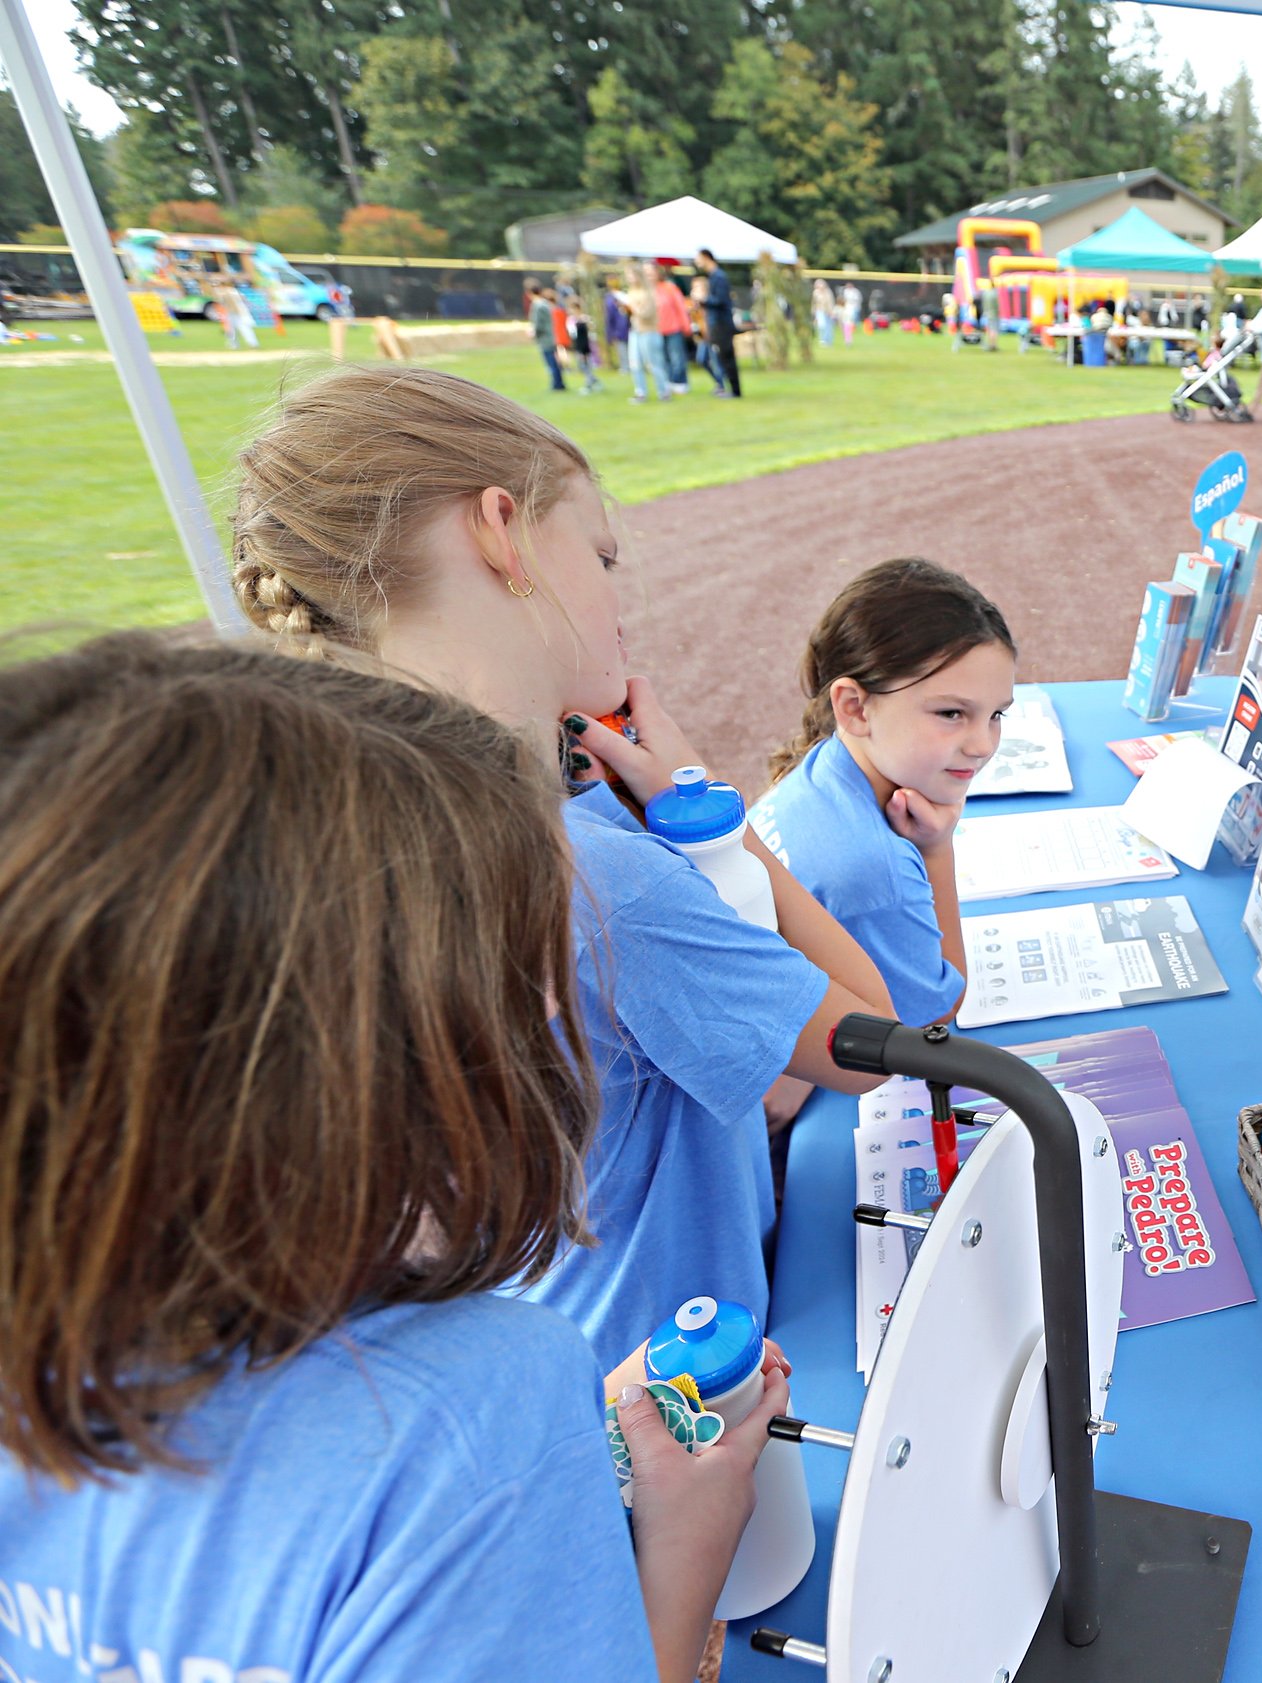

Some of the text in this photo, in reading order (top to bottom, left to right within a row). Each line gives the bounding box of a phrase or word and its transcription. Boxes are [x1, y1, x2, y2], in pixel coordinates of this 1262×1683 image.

[1194, 467, 1244, 513] Español
[1158, 931, 1191, 990] EARTHQUAKE
[1125, 1153, 1181, 1273] with Pedro!
[1153, 1144, 1211, 1265] Prepare
